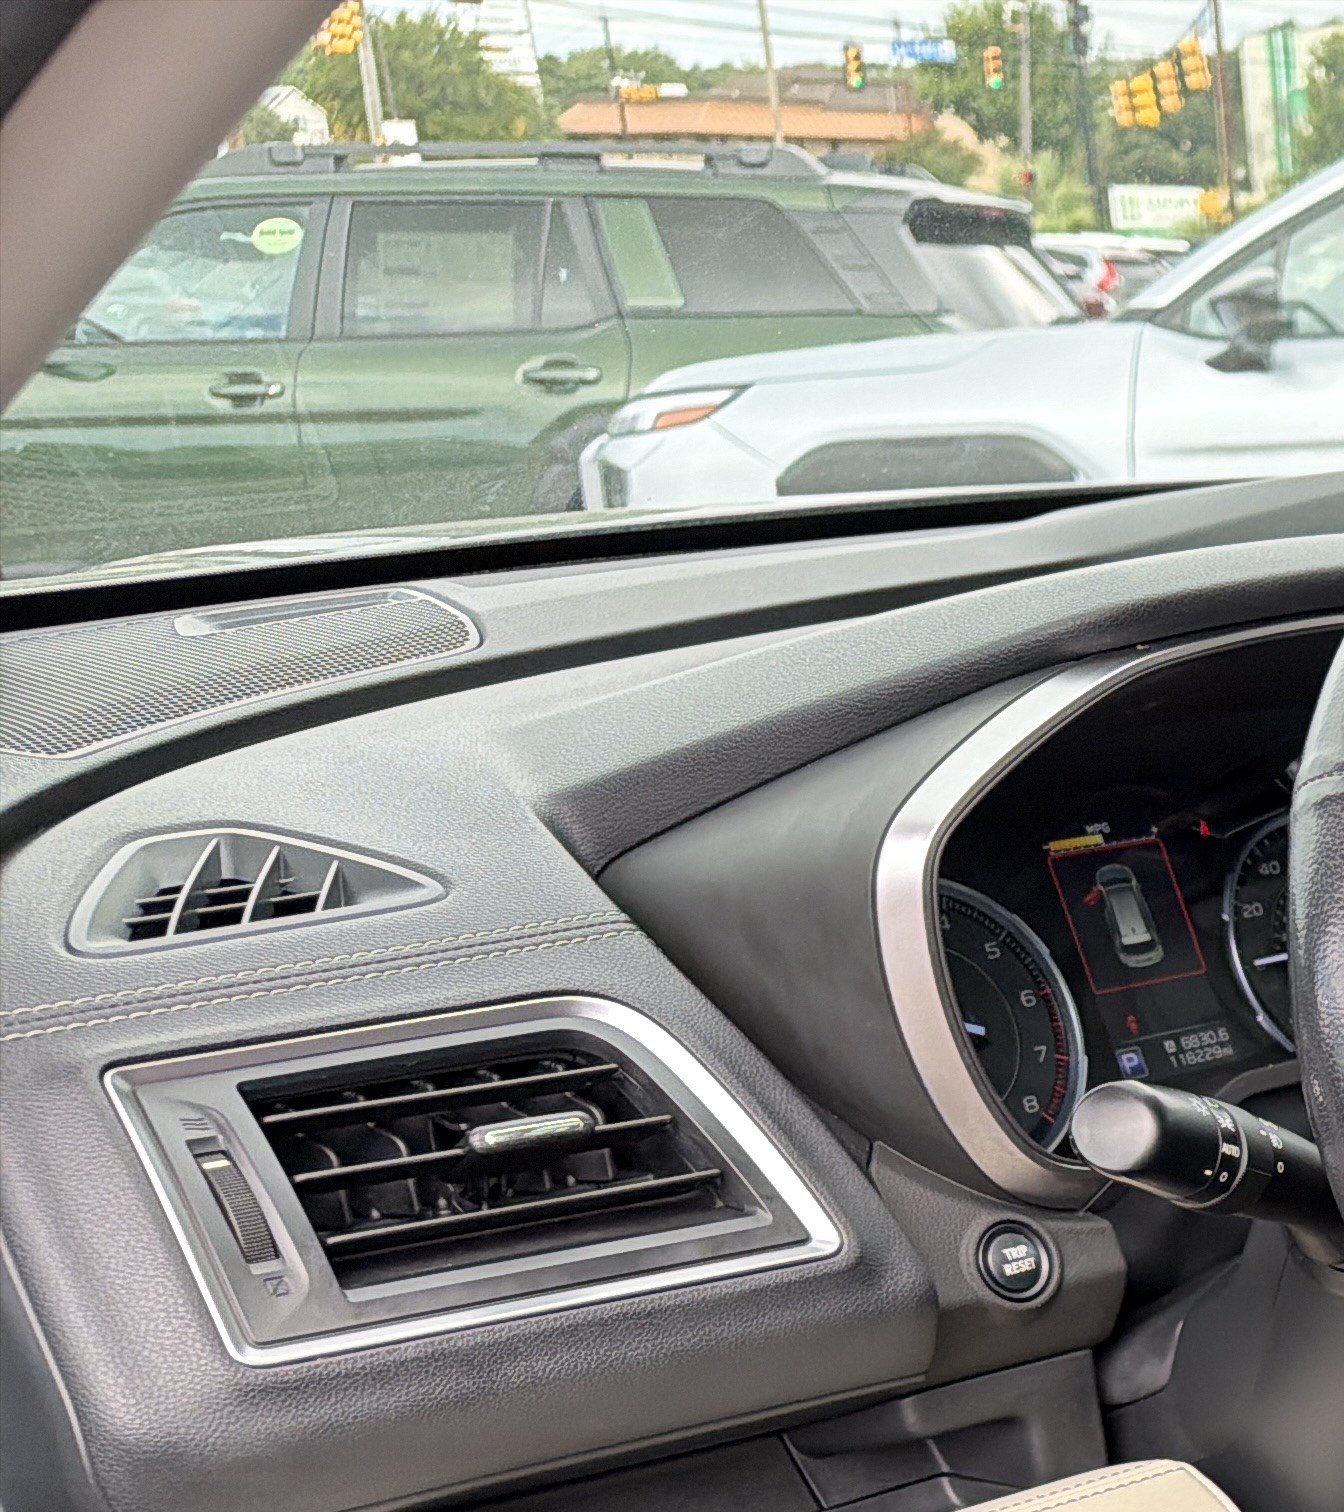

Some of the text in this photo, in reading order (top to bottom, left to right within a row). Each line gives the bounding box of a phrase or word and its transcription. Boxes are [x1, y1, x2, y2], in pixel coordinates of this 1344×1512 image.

[1241, 902, 1264, 919] 20
[984, 941, 1001, 960] 5
[1020, 989, 1037, 1008] 6
[1033, 1045, 1047, 1063] 7
[1121, 1052, 1139, 1075] P
[1022, 1095, 1040, 1114] 8
[1001, 1244, 1028, 1261] TRIP
[1003, 1257, 1036, 1276] RESET
